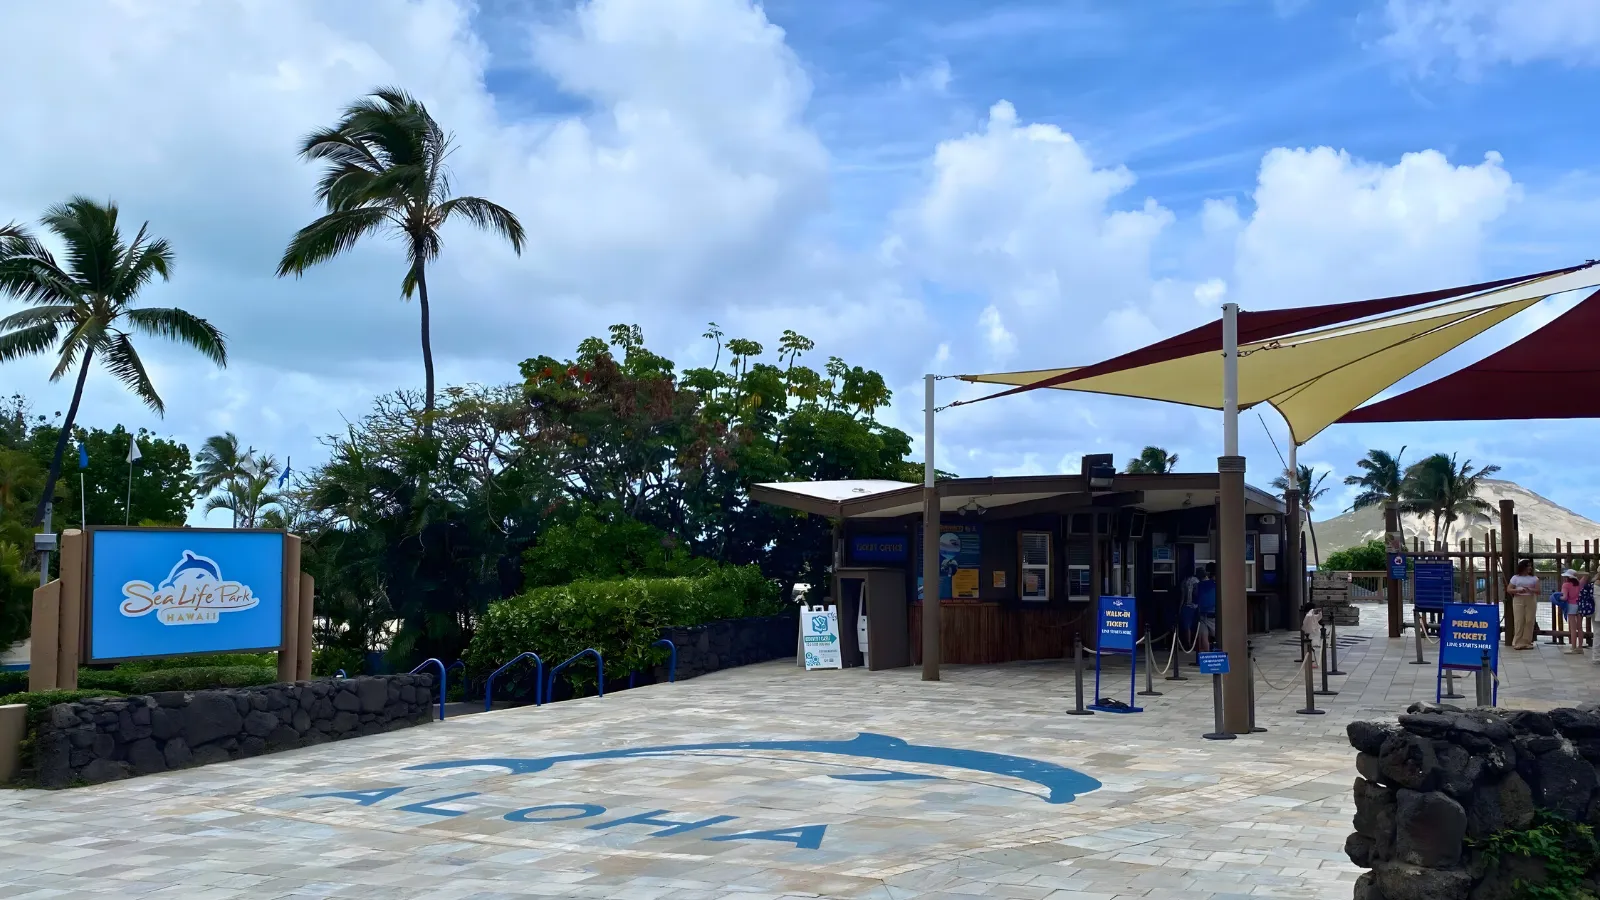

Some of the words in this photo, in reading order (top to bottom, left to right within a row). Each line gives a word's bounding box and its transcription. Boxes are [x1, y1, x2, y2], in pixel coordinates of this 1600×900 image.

[123, 583, 174, 613] Sea
[178, 583, 214, 611] Life
[214, 584, 250, 603] Park
[1452, 620, 1488, 628] PREPAID
[1453, 632, 1487, 640] TICKETS
[300, 786, 829, 850] ALOHA
